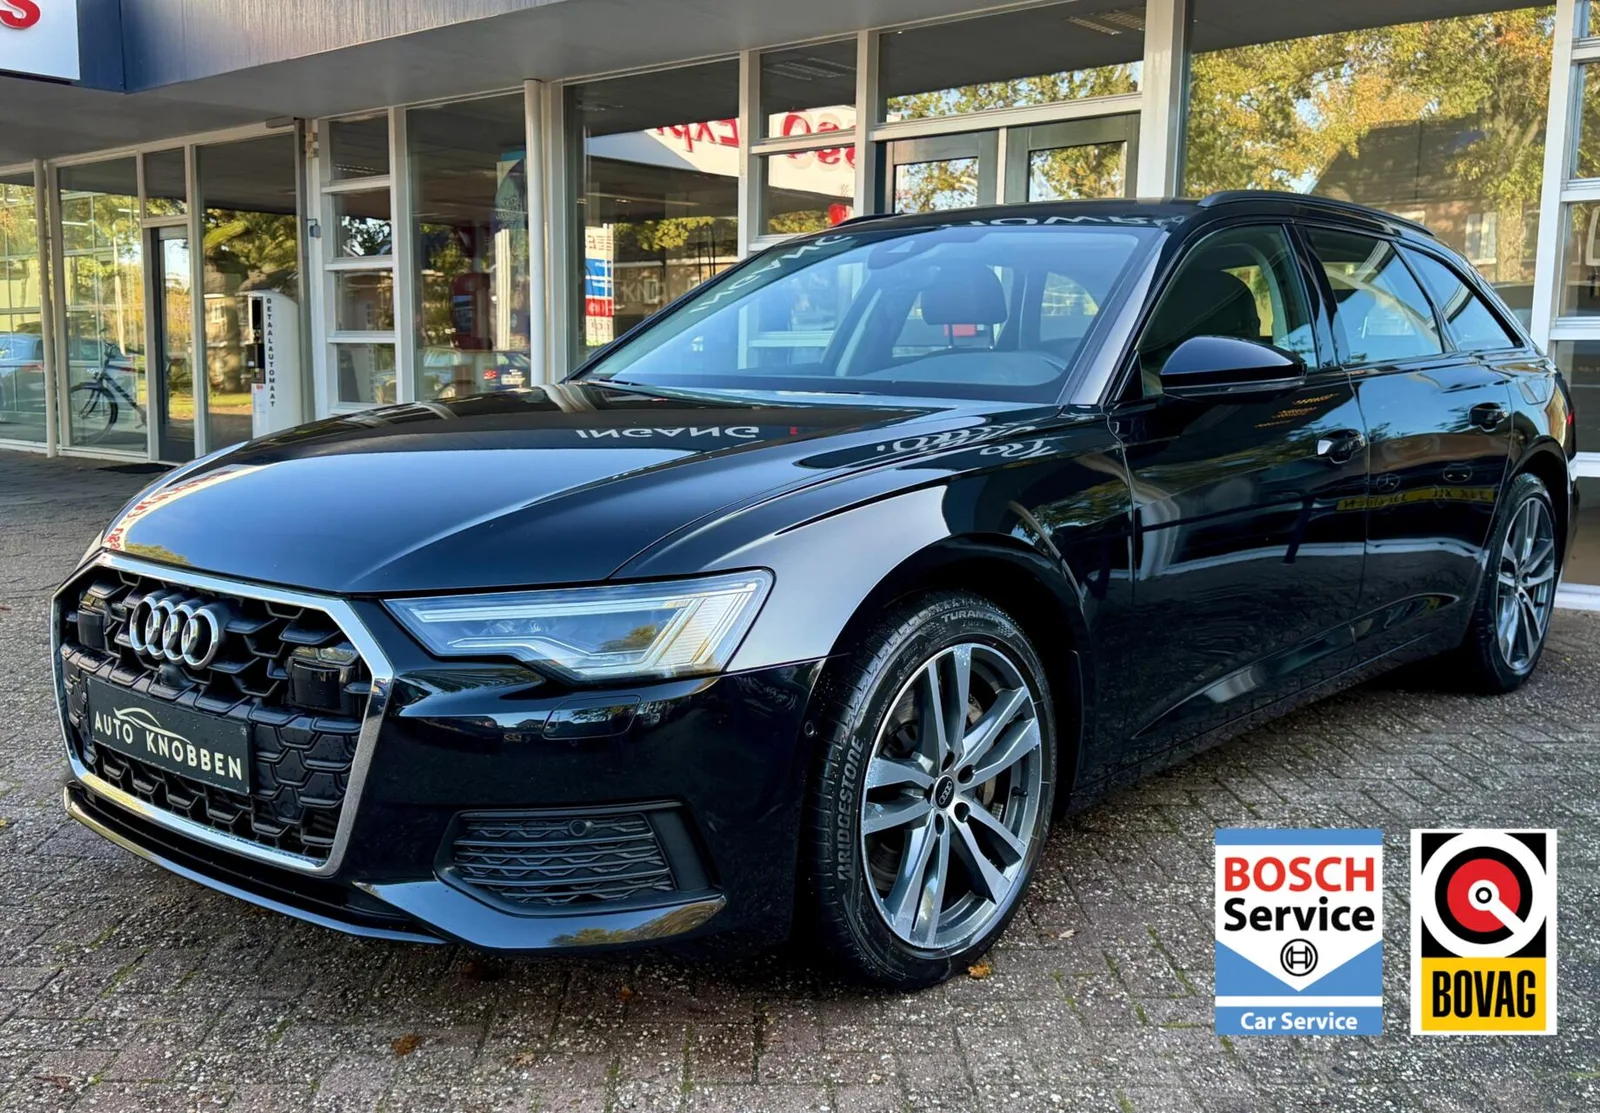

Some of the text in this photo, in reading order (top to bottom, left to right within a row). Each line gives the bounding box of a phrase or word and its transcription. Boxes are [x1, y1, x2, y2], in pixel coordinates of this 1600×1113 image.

[266, 297, 275, 408] BETAALAUTOMAAT
[94, 711, 242, 781] AUTO KNOBBEN
[837, 735, 864, 880] BRIDGESTONE
